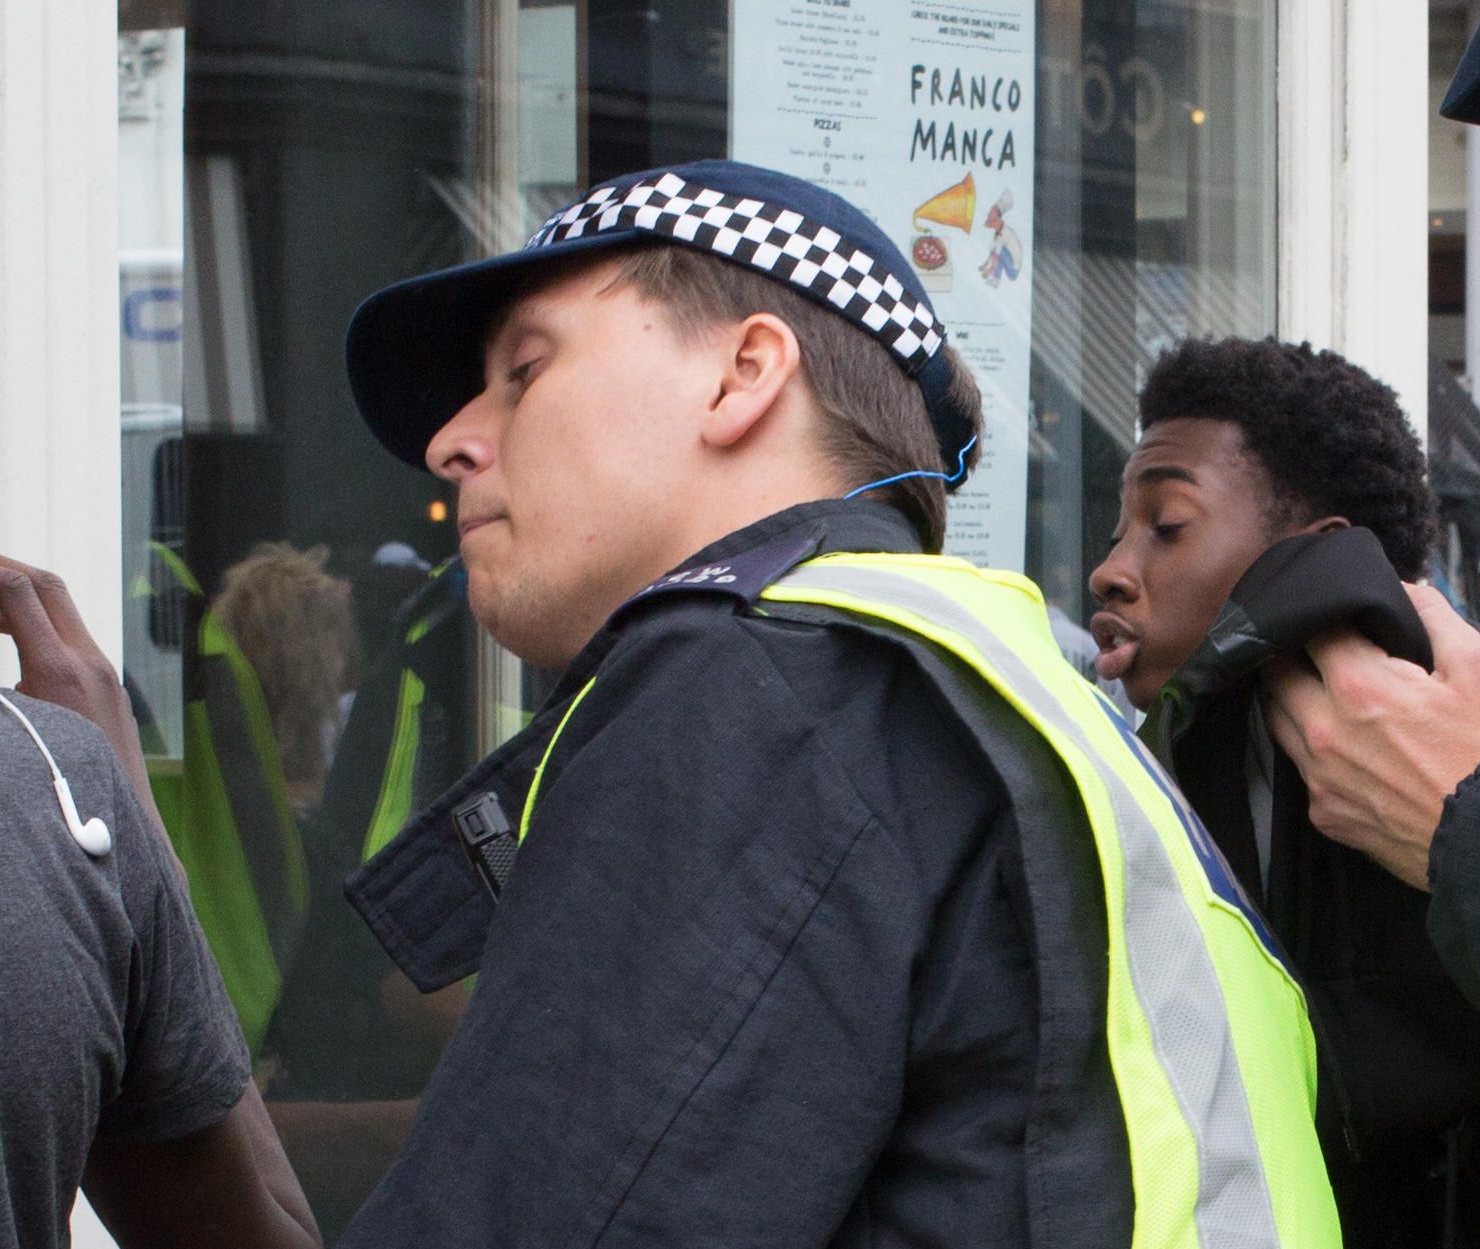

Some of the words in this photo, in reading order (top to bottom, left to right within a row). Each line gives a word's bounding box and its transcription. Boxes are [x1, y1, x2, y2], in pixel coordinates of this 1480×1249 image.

[911, 63, 1021, 113] FRANCO
[813, 118, 842, 131] PIZZAS
[909, 117, 1016, 171] MANCA
